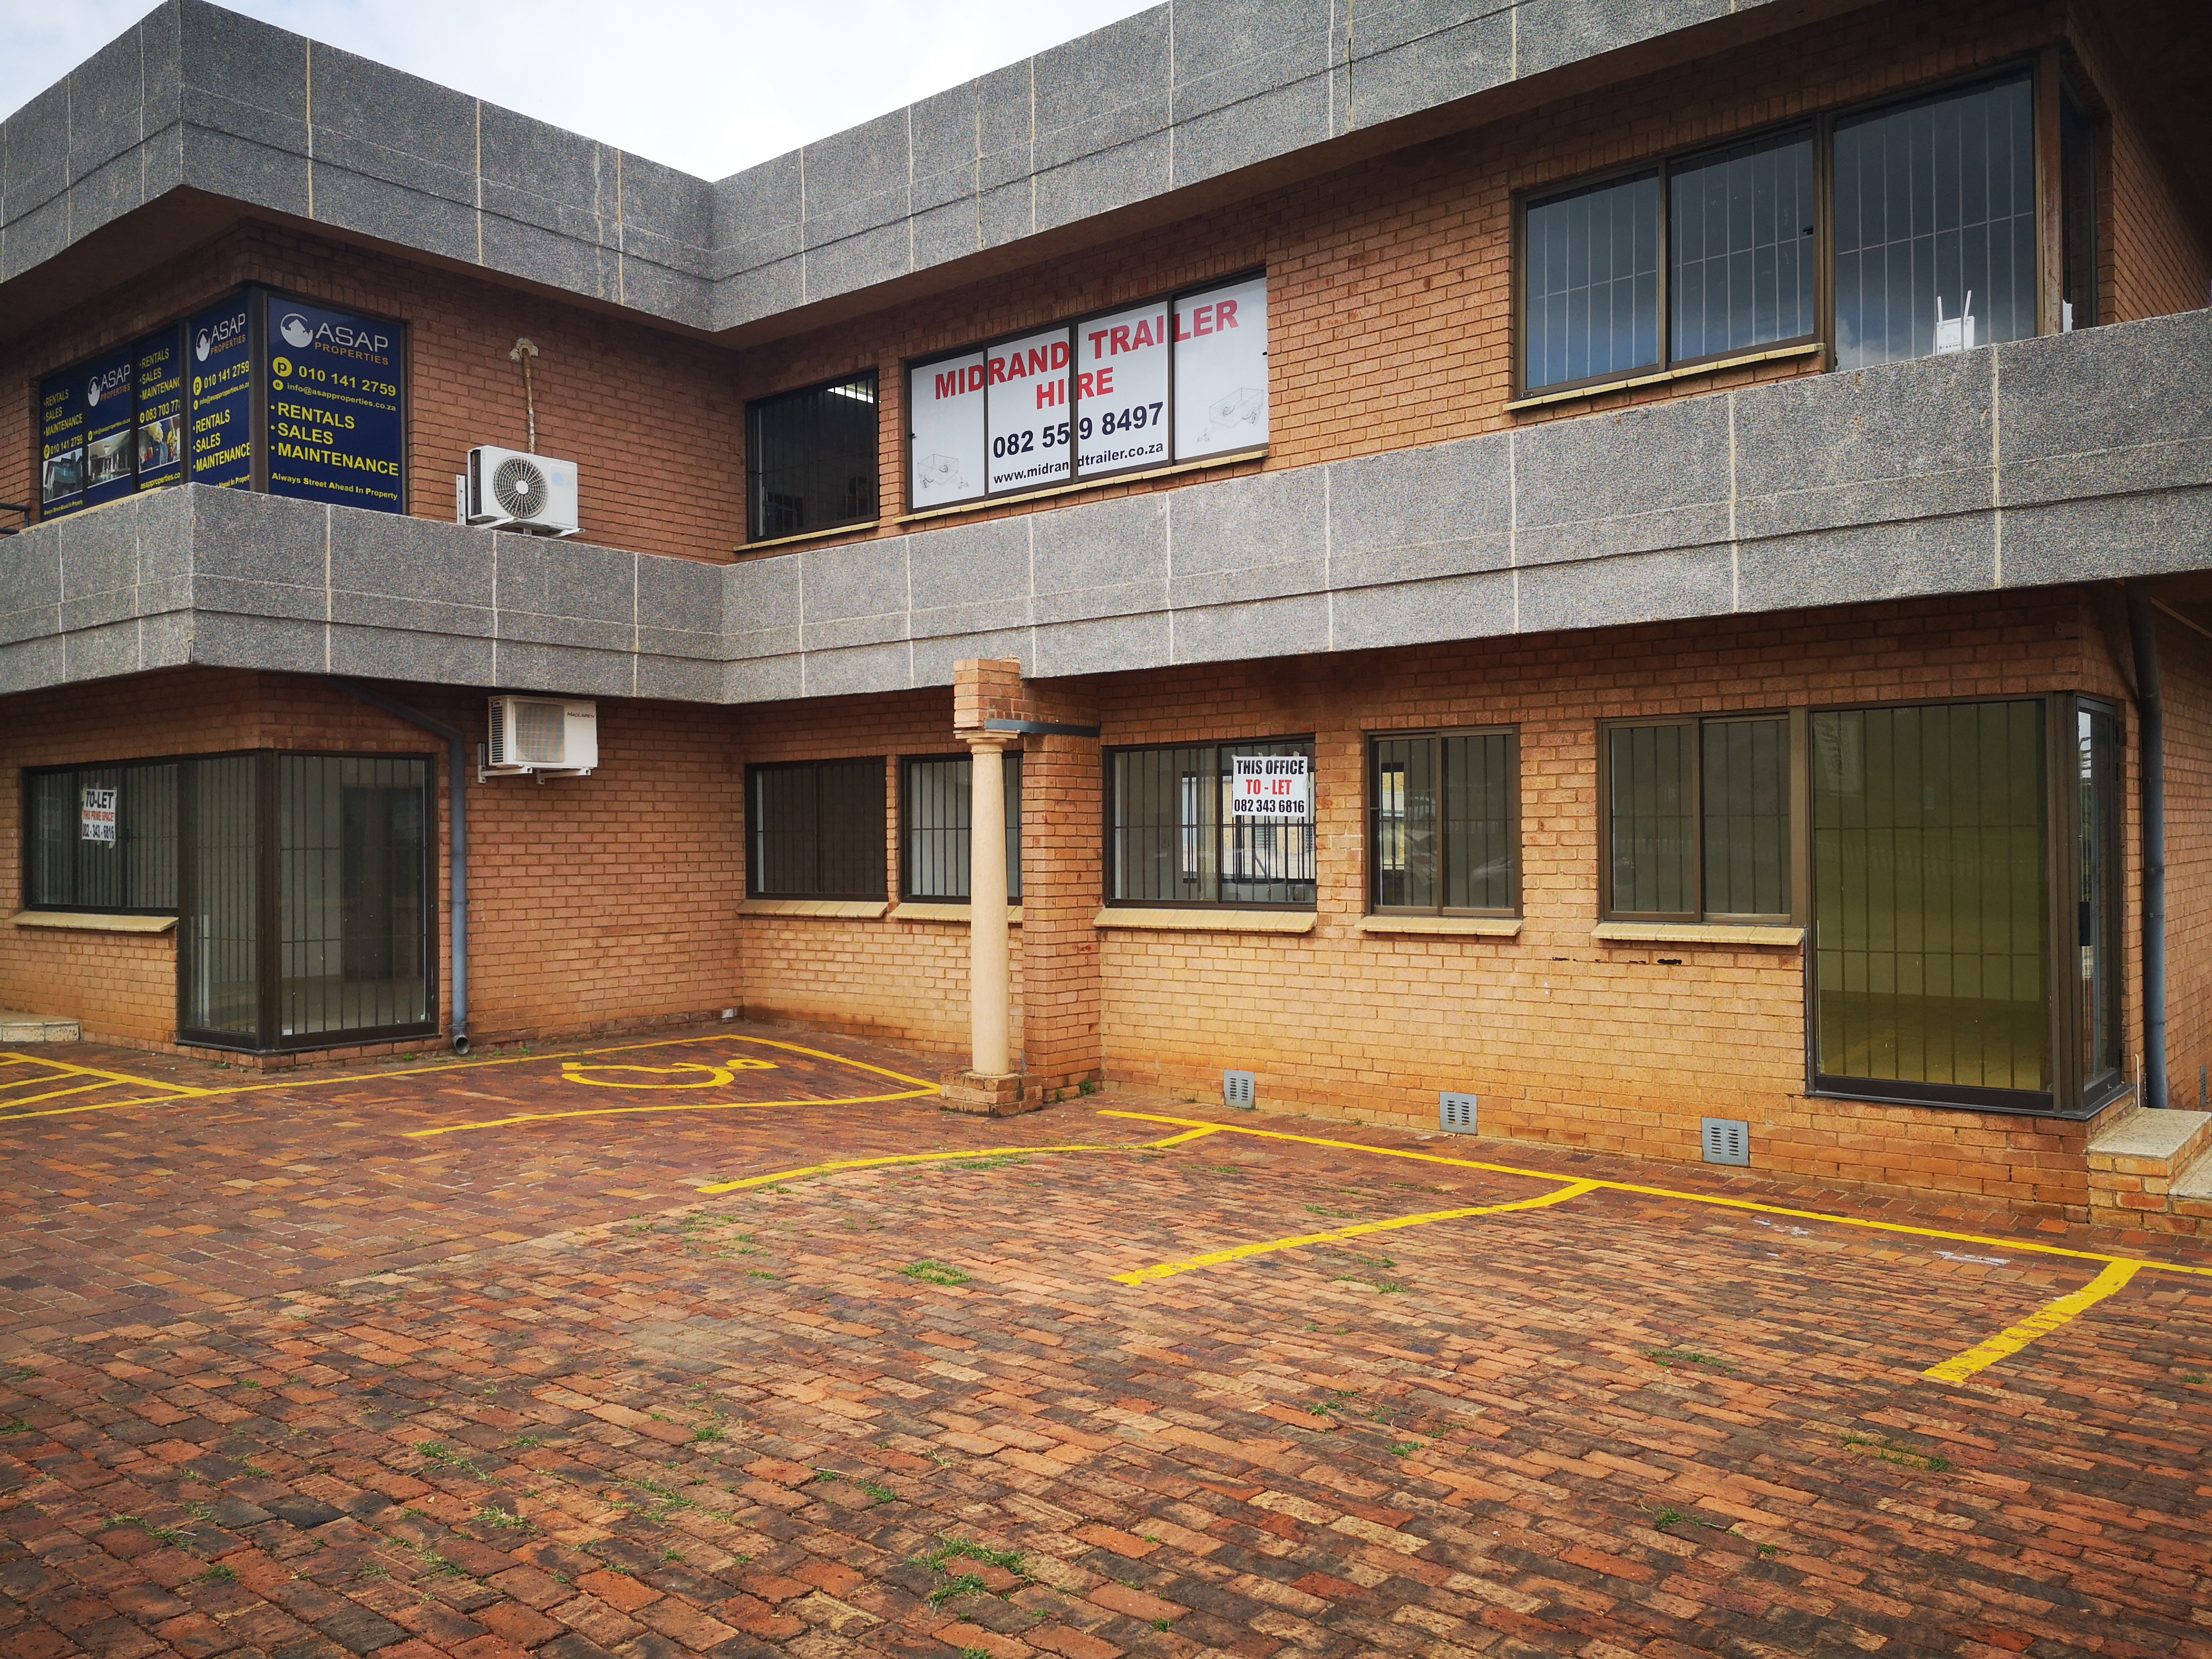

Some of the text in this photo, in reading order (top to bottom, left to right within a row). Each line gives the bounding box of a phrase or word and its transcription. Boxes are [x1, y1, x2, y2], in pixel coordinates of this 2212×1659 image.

[211, 313, 246, 345] ASAP
[315, 322, 389, 353] ASAP
[211, 334, 246, 356] PROPERTIES
[315, 342, 389, 366] PROPERTIES
[935, 299, 1239, 400] MIDRAND TRAILER
[142, 348, 169, 369] RENTALS
[101, 364, 130, 391] ASAP
[142, 367, 162, 385] SALES
[204, 373, 216, 389] 010
[218, 368, 230, 383] 141
[232, 361, 250, 377] 2759
[299, 366, 326, 382] 010
[331, 373, 356, 389] 141
[362, 379, 396, 397] 2759
[46, 389, 69, 408] RENTALS
[287, 382, 396, 412] info@asapproperties.co.za
[1036, 367, 1114, 410] HIRE
[46, 406, 62, 422] SALES
[46, 413, 83, 436] MAINTENANCE
[145, 407, 157, 422] 083
[158, 402, 169, 417] 703
[196, 409, 230, 434] RENTALS
[278, 402, 355, 429] RENTALS
[278, 423, 333, 445] SALES
[993, 430, 1034, 458] 082
[1102, 401, 1163, 435] 8497
[50, 443, 60, 455] 010
[61, 439, 69, 451] 141
[196, 433, 221, 453] SALES
[196, 442, 250, 472] MAINTENANCE
[278, 442, 399, 477] MAINTENANCE
[993, 443, 1164, 484] www.midrandtrailer.co.za
[271, 473, 301, 484] Always
[303, 478, 327, 488] Street
[329, 482, 353, 492] Ahead
[366, 488, 397, 501] Property
[1236, 760, 1304, 775] THIS OFFICE
[1245, 779, 1261, 795] TO
[1272, 779, 1292, 795] LET
[1234, 799, 1304, 813] 082 343 6816
